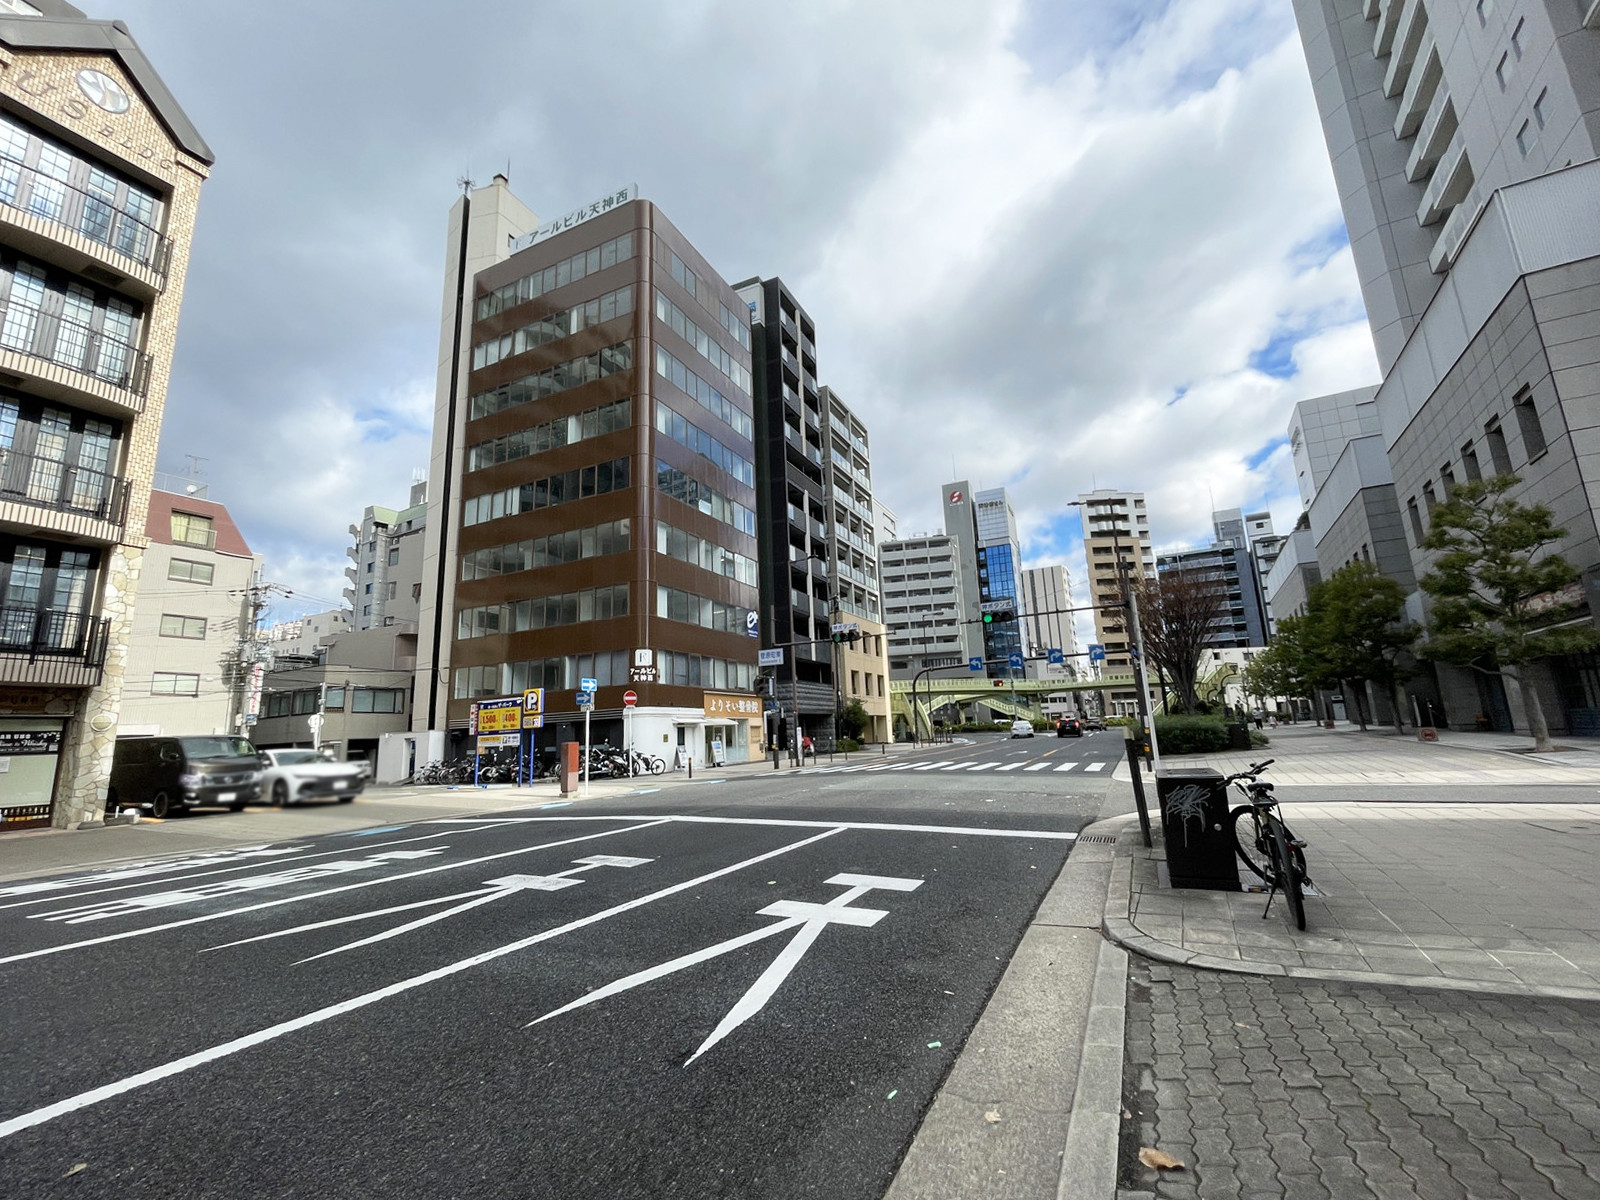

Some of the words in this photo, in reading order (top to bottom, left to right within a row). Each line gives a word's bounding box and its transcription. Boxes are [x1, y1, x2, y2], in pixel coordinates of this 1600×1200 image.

[97, 124, 174, 171] BLDG
[528, 188, 630, 245] アールビル天神西
[629, 667, 657, 676] アールビル
